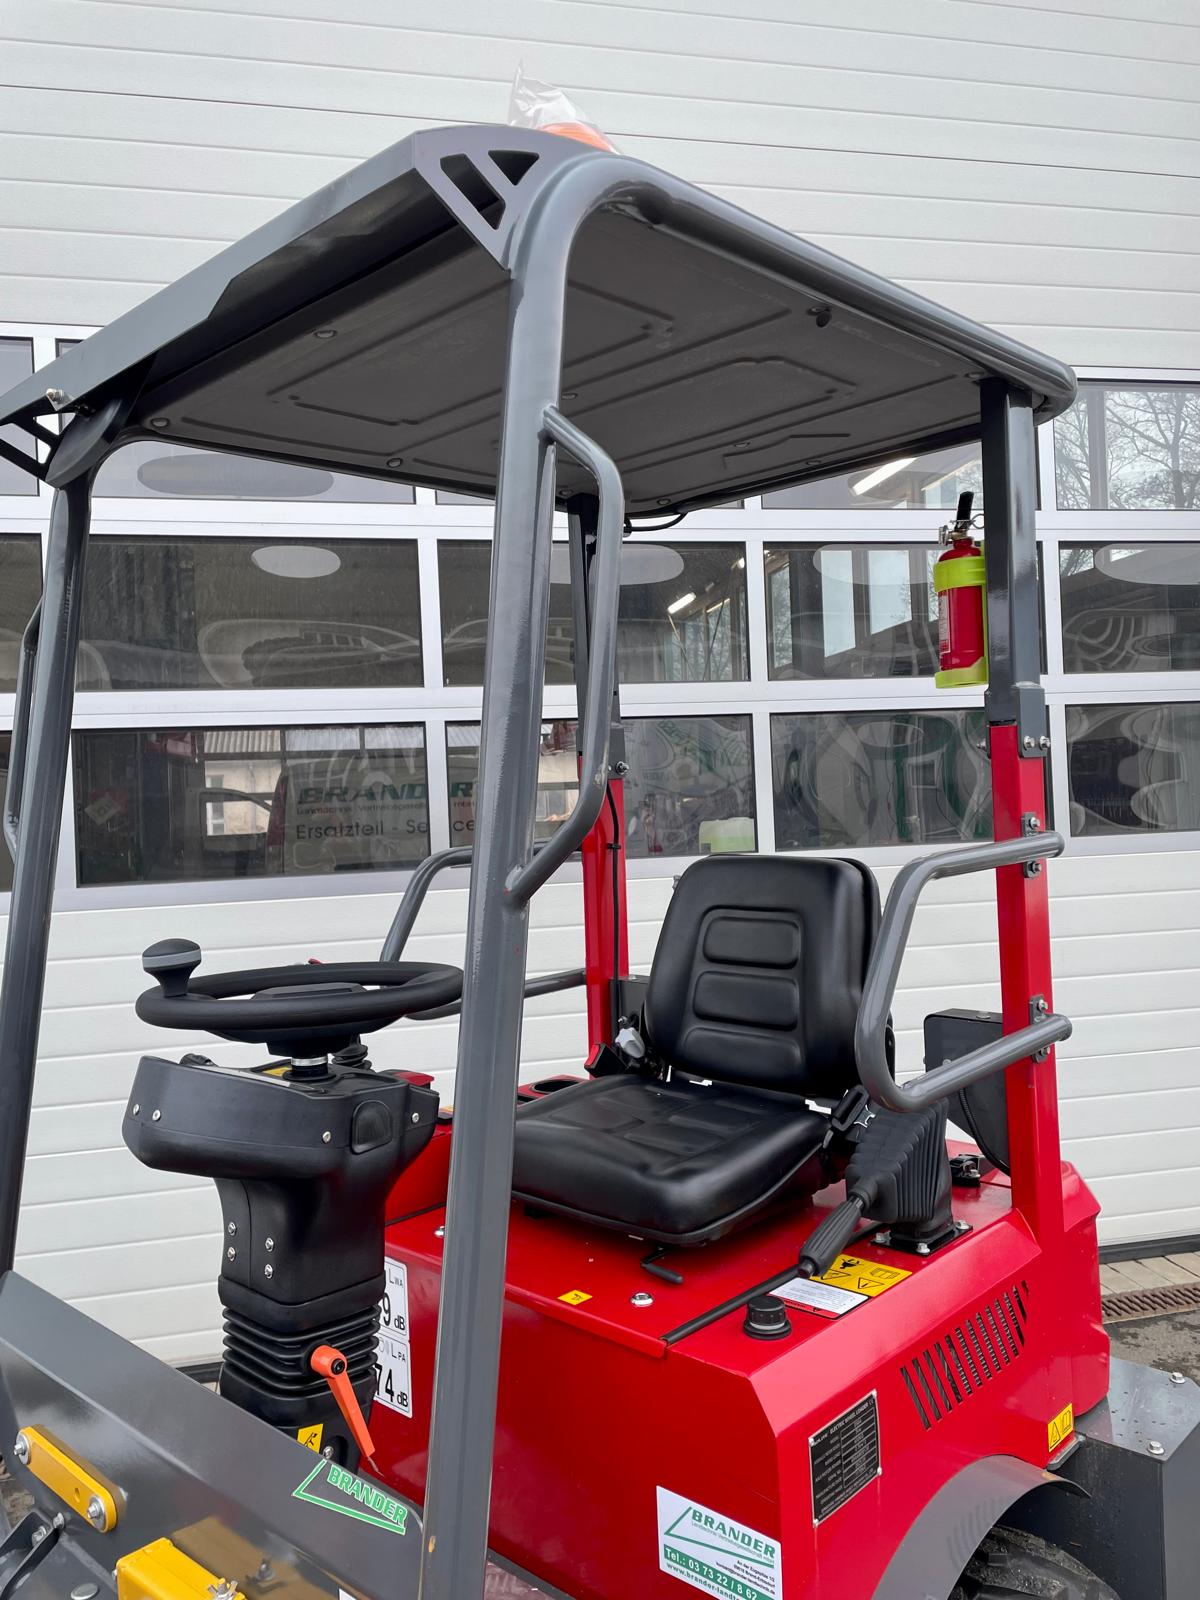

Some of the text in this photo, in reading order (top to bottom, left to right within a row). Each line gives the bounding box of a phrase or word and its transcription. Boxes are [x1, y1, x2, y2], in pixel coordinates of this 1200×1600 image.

[298, 782, 475, 804] BRANDR
[393, 1315, 406, 1331] dB
[396, 1391, 409, 1408] dB
[326, 1463, 408, 1527] BRANDER
[691, 1508, 776, 1559] BRANDER
[665, 1547, 686, 1566] Tel.:
[688, 1559, 700, 1572] 03
[702, 1565, 714, 1579] 73
[716, 1573, 729, 1587] 22
[737, 1583, 743, 1594] 8
